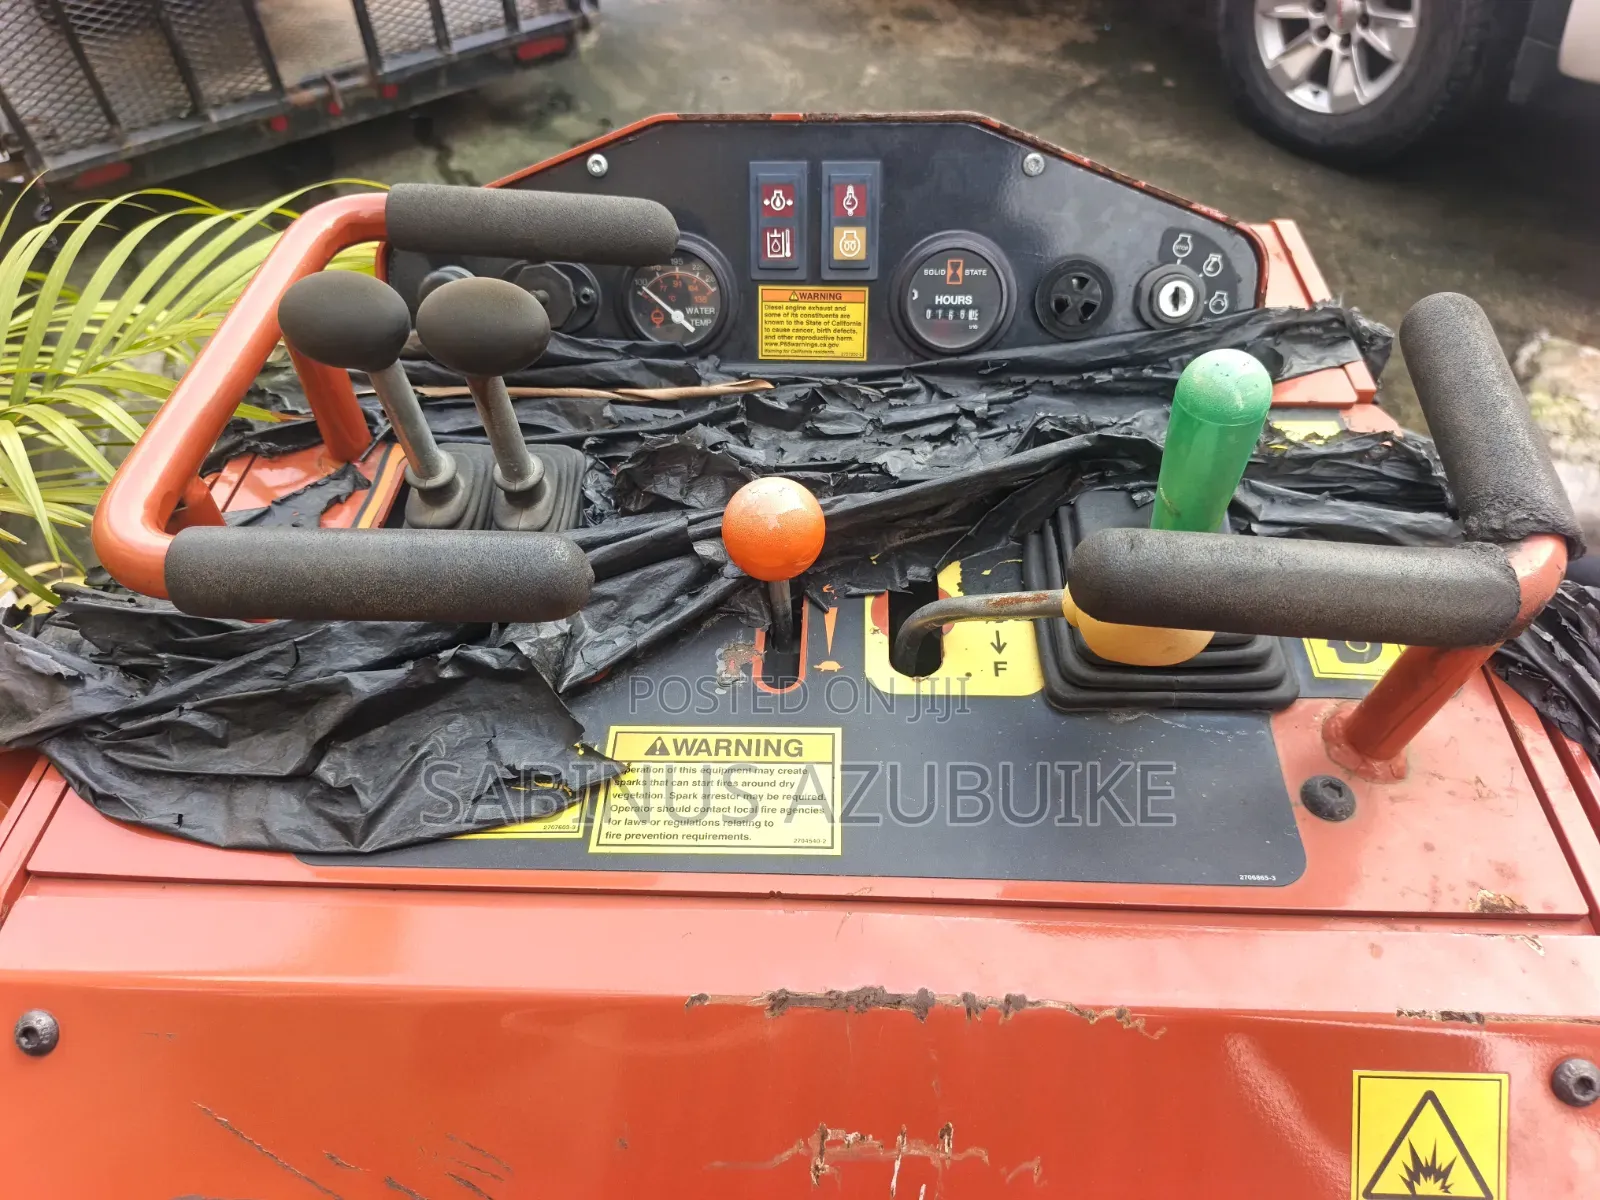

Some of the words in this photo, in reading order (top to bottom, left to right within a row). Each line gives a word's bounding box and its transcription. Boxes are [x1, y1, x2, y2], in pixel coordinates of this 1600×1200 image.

[934, 295, 972, 305] HOURS
[993, 661, 1008, 676] F
[672, 738, 803, 757] WARNING
[700, 767, 752, 775] equipment
[614, 779, 647, 787] sparks
[779, 780, 795, 788] dry
[669, 792, 698, 800] Spark
[782, 794, 826, 802] required.
[610, 805, 654, 813] Operator
[780, 806, 825, 815] agencies
[663, 819, 720, 828] regulations
[722, 820, 761, 829] relating
[605, 831, 622, 839] fire
[624, 831, 678, 840] prevention
[681, 833, 751, 841] requirements.
